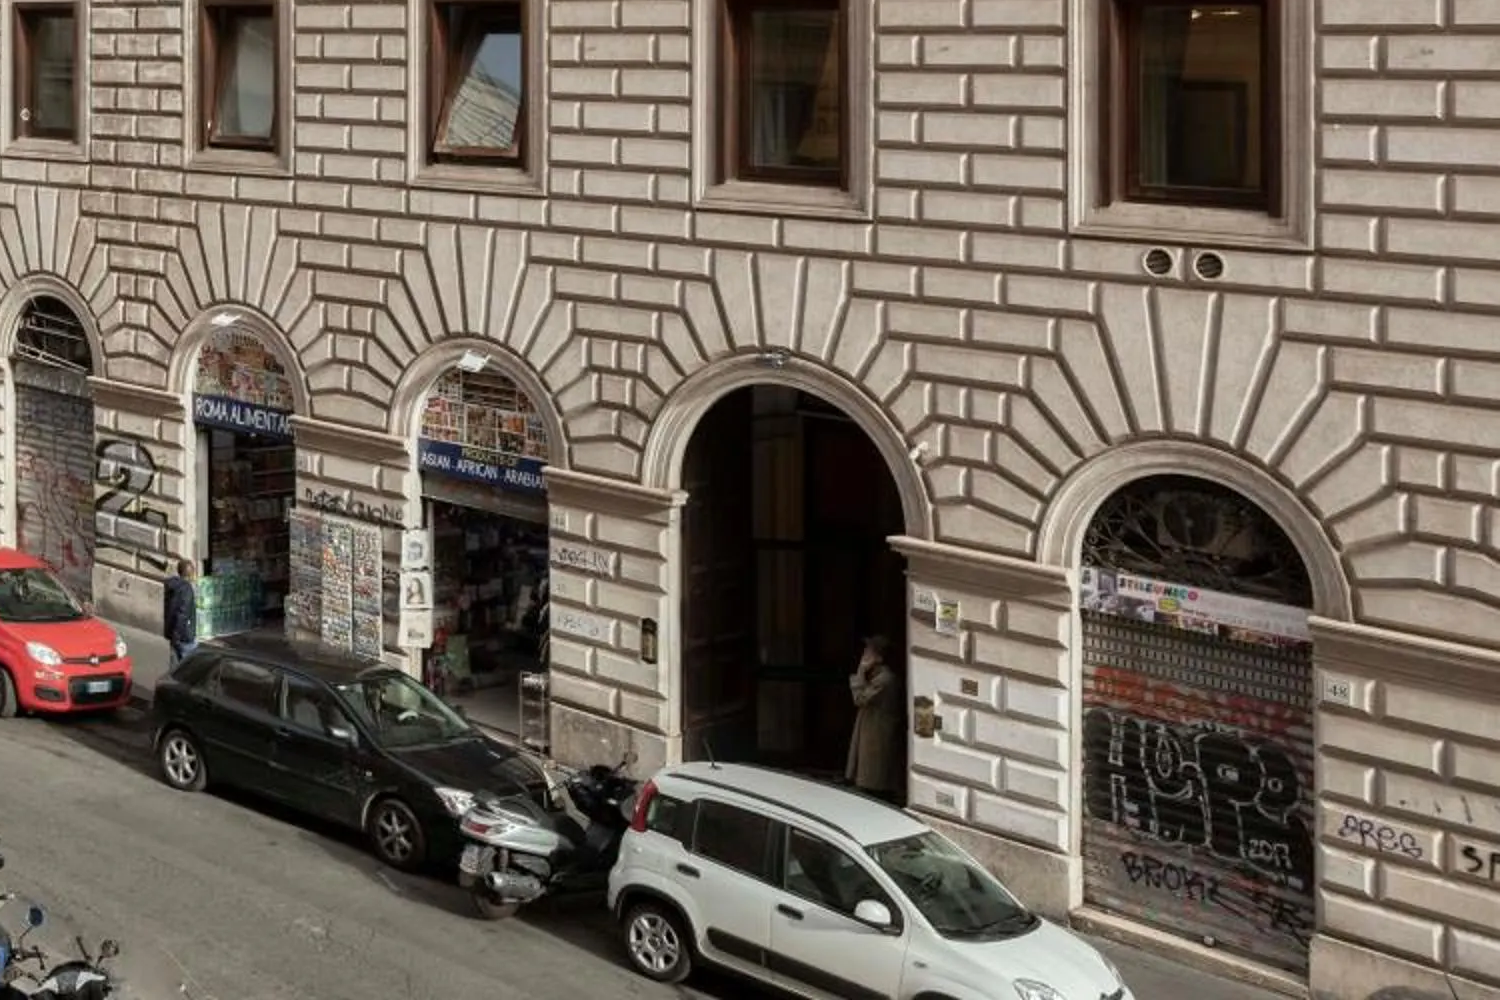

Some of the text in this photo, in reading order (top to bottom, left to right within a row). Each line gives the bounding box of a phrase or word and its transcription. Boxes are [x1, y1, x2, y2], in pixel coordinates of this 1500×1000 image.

[196, 397, 229, 421] ROMA
[420, 451, 451, 470] ASIAN
[456, 458, 499, 479] AFRICAN
